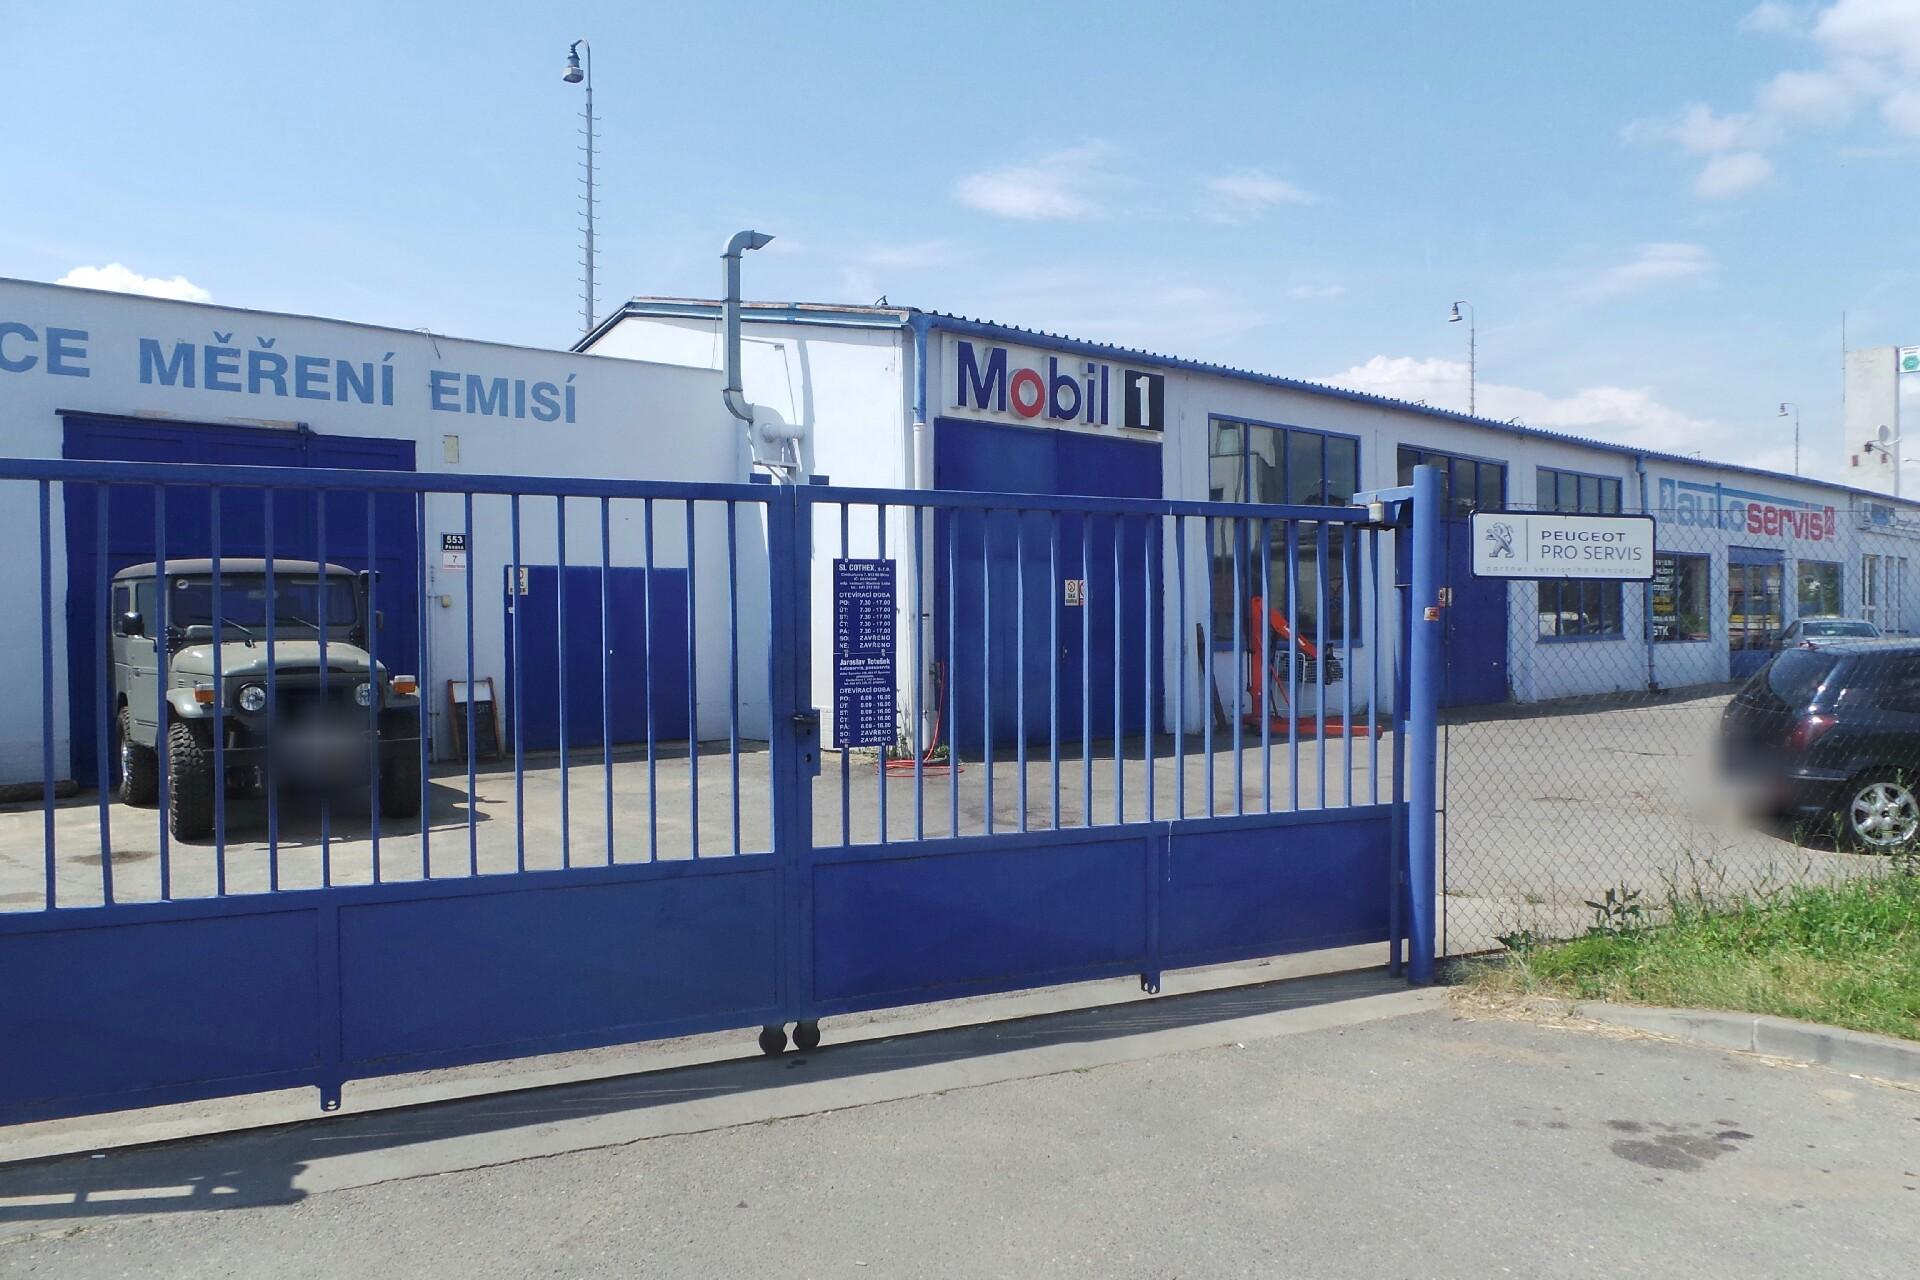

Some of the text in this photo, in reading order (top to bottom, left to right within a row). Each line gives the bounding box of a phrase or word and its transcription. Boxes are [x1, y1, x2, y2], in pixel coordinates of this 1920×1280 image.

[139, 330, 395, 406] MĚŘENÍ
[429, 369, 577, 424] EMISÍ
[957, 340, 1151, 427] Mobil 1
[446, 535, 464, 544] 553
[1541, 530, 1626, 543] PEUGEOT
[1541, 545, 1642, 561] PRO SERVIS
